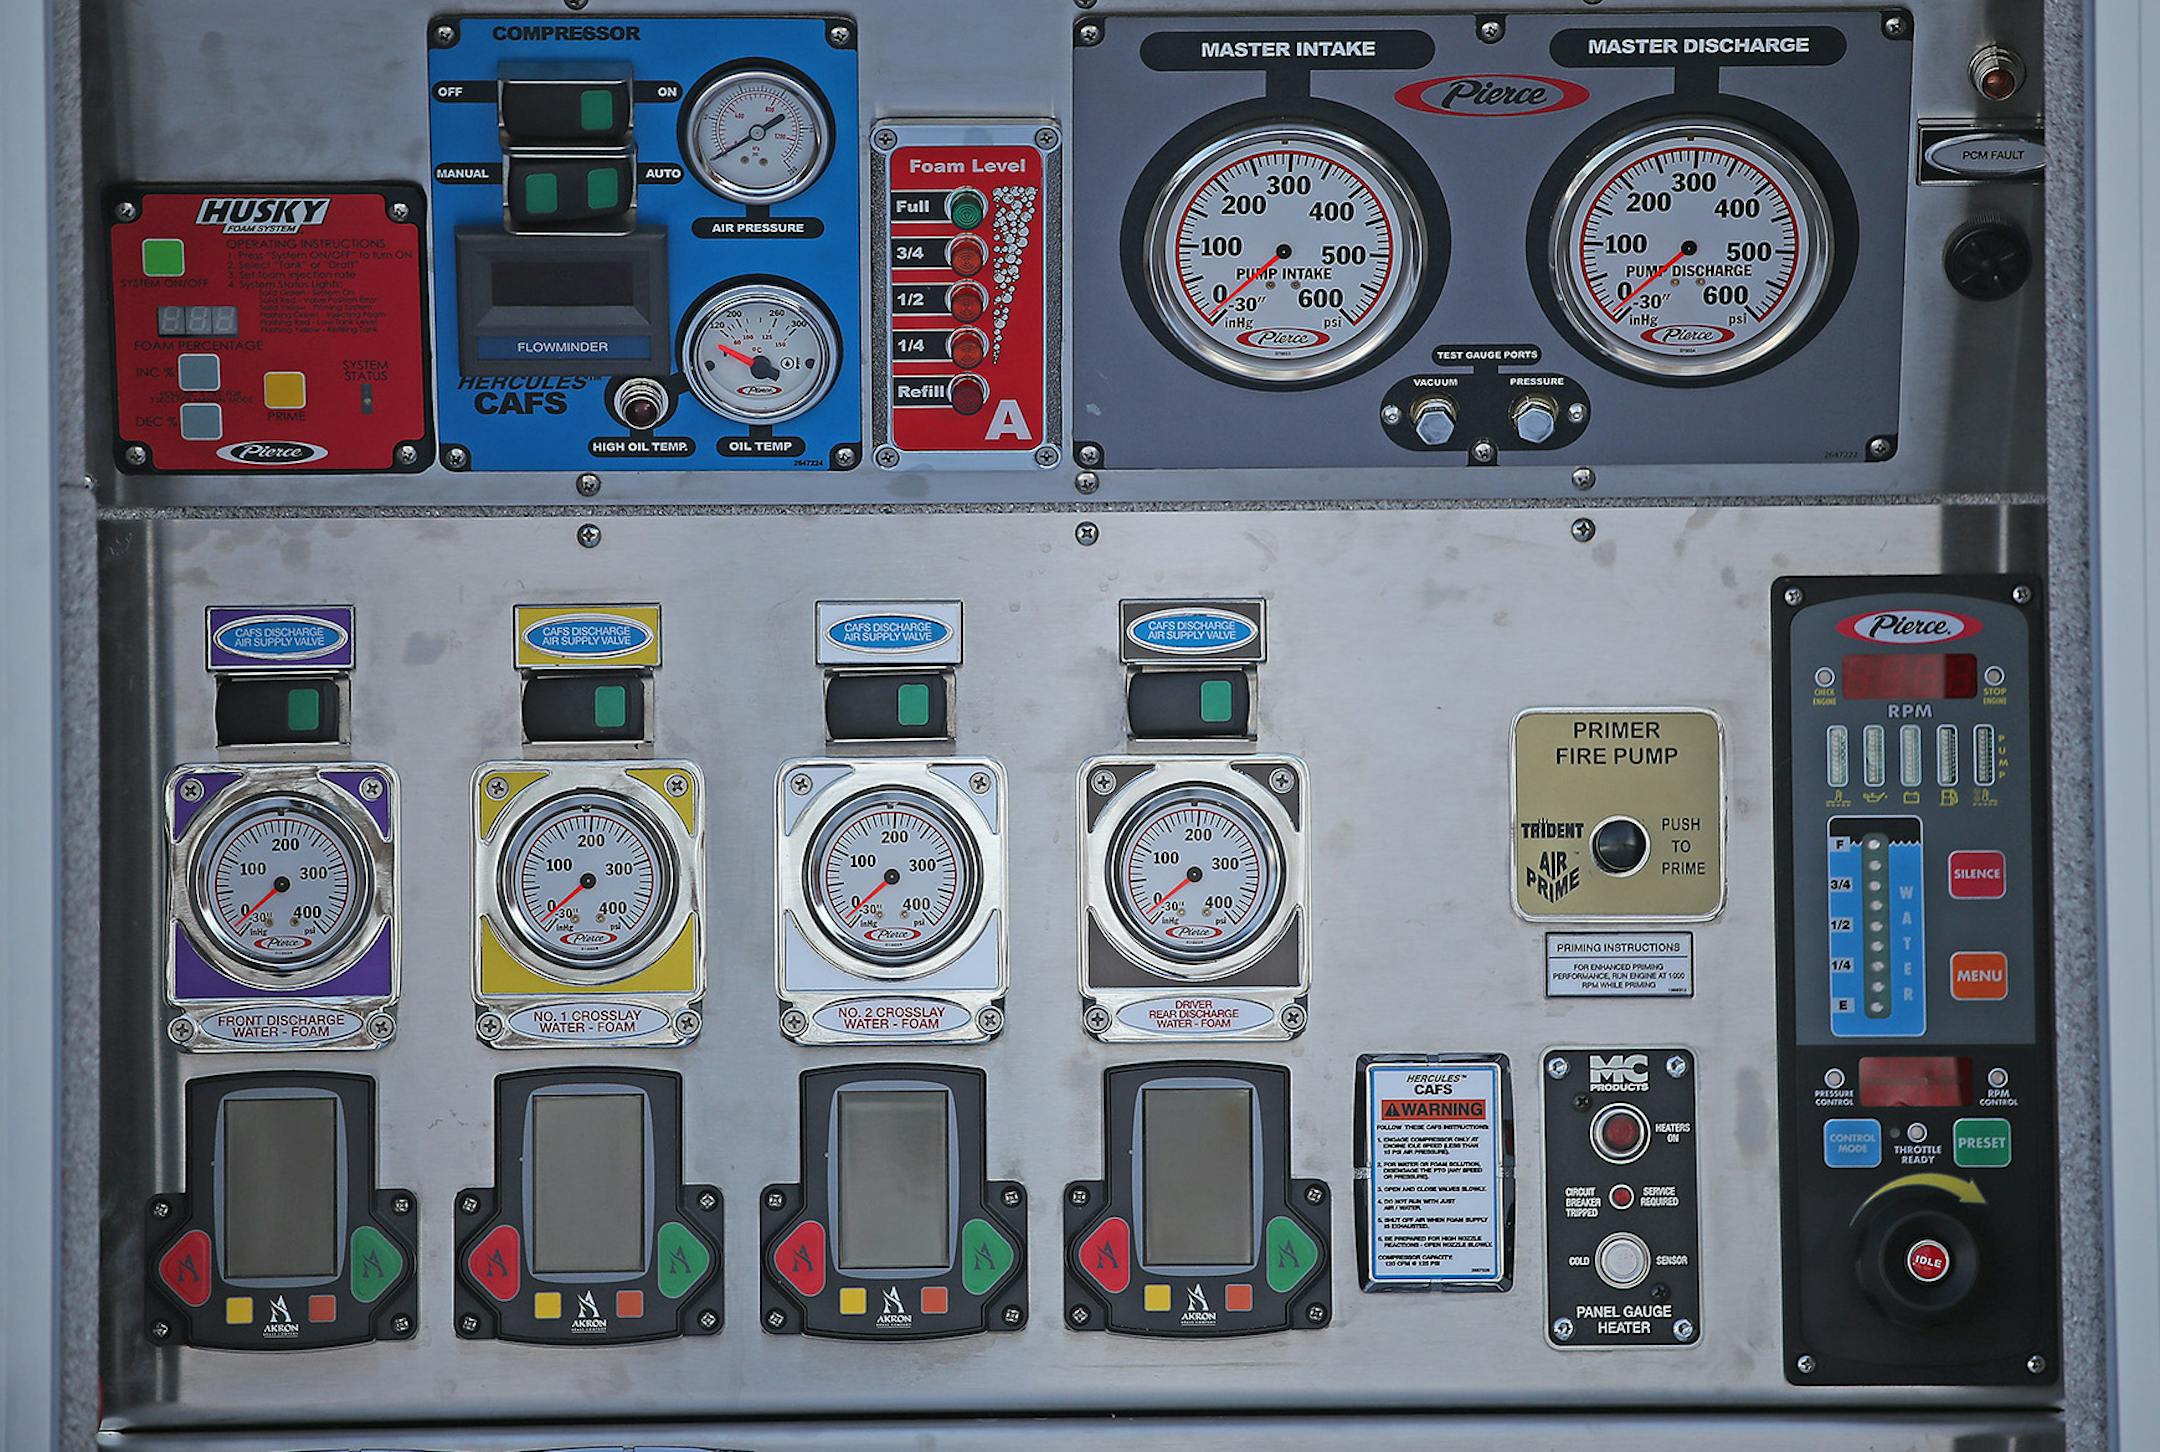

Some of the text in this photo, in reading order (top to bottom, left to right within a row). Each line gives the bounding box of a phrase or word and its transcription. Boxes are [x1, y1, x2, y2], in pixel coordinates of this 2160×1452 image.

[493, 27, 640, 41] COMPRESSOR
[1202, 42, 1375, 57] MASTER INTAKE
[1589, 38, 1809, 54] MASTER DISCHARGE
[438, 88, 462, 97] OFF
[658, 87, 677, 97] ON
[1442, 80, 1547, 109] Pierce
[1963, 151, 2024, 160] PCM FAULT
[910, 159, 1026, 173] Foam Level
[437, 170, 489, 179] MANUAL
[646, 169, 682, 179] AUTO
[1267, 176, 1310, 194] 300
[1672, 173, 1716, 192] 300
[897, 200, 929, 213] Full
[1221, 196, 1266, 215] 200
[1626, 193, 1671, 212] 200
[202, 199, 328, 223] HUSKY
[1309, 202, 1354, 221] 400
[1714, 199, 1760, 218] 400
[712, 224, 804, 233] AIR PRESSURE
[226, 239, 386, 249] OPERATING INSTRUCTIONS
[1201, 237, 1242, 256] 100
[1606, 235, 1647, 254] 100
[897, 247, 924, 259] 3/4
[1322, 246, 1365, 265] 500
[1726, 242, 1772, 261] 500
[1282, 268, 1331, 280] INTAKE
[1672, 265, 1751, 277] DISCHARGE
[897, 294, 924, 306] 1/2
[1299, 289, 1343, 307] 600
[1703, 286, 1748, 305] 600
[135, 341, 263, 350] FOAM PERCENTAGE
[518, 342, 608, 352] FLOWMINDER
[898, 339, 924, 351] 1/4
[1466, 351, 1501, 359] GAUGE
[1504, 351, 1538, 359] PORTS
[344, 361, 389, 370] SYSTEM
[136, 368, 159, 377] INC
[344, 372, 388, 381] STATUS
[1510, 378, 1564, 386] PRESSURE
[898, 386, 944, 398] Refill
[475, 392, 567, 415] CAFS
[268, 412, 305, 421] PRIME
[985, 400, 1032, 440] A
[136, 417, 164, 427] DEC
[593, 442, 627, 452] HIGH
[630, 442, 650, 452] OIL
[729, 441, 792, 451] OIL TEMP
[239, 444, 302, 459] Pierce
[844, 623, 931, 631] CAFS DISCHARGE
[1148, 621, 1235, 630] CAFS DISCHARGE
[236, 628, 324, 637] CAFS DISCHARGE
[543, 627, 630, 636] CAFS DISCHARGE
[844, 632, 932, 641] AIR SUPPLY VALVE
[1148, 631, 1236, 640] AIR SUPPLY VALVE
[235, 637, 324, 646] AIR SUPPLY VALVE
[542, 636, 631, 645] AIR SUPPLY VALVE
[1888, 705, 1932, 718] RPM
[1574, 722, 1660, 738] PRIMER
[1557, 748, 1678, 764] FIRE PUMP
[1662, 818, 1700, 831] PUSH
[1672, 840, 1691, 852] TO
[1837, 840, 1843, 848] F
[1539, 851, 1567, 880] AIR
[1662, 862, 1705, 875] PRIME
[1954, 869, 2000, 879] SILENCE
[1527, 867, 1580, 903] PRIME
[1831, 881, 1850, 889] 3/4
[1831, 921, 1850, 930] 1/2
[1557, 943, 1680, 952] PRIMING INSTRUCTIONS
[1900, 886, 1914, 1000] WATER
[1832, 961, 1851, 969] 1/4
[1957, 970, 2002, 982] MENU
[1175, 1001, 1212, 1009] DRIVER
[1839, 1001, 1847, 1010] E
[534, 1011, 642, 1021] NO. 1 CROSSLAY
[839, 1007, 945, 1017] NO. 2 CROSSLAY
[1150, 1009, 1239, 1019] REAR DISCHARGE
[218, 1015, 345, 1026] FRONT DISCHARGE
[844, 1019, 939, 1029] WATER FOAM
[1157, 1019, 1231, 1028] WATER FOAM
[233, 1027, 330, 1037] WATER FOAM
[540, 1022, 635, 1032] WATER FOAM
[1590, 1054, 1648, 1083] MC
[1414, 1084, 1452, 1094] CAFS
[1590, 1083, 1649, 1091] PRODUCTS
[1815, 1090, 1854, 1098] PRESSURE
[1988, 1089, 2010, 1098] RPM
[1401, 1103, 1483, 1116] WARNING
[1655, 1124, 1690, 1132] HEATERS
[1667, 1134, 1679, 1142] ON
[1830, 1134, 1876, 1143] CONTROL
[1958, 1137, 2006, 1149] PRESET
[1838, 1145, 1868, 1153] MODE
[1894, 1146, 1942, 1154] THROTTLE
[1901, 1156, 1935, 1164] READY
[1565, 1187, 1596, 1196] CIRCUIT
[1643, 1187, 1675, 1196] SERVICE
[1566, 1198, 1601, 1207] BREAKER
[1641, 1197, 1679, 1206] REQUIRED
[1566, 1209, 1598, 1217] TRIPPED
[1569, 1257, 1590, 1266] COLD
[1656, 1256, 1688, 1265] SENSOR
[1914, 1255, 1942, 1268] IDLE
[1181, 1312, 1216, 1321] AKRON
[1576, 1305, 1672, 1318] PANEL GAUGE
[571, 1319, 607, 1328] AKRON
[877, 1315, 912, 1323] AKRON
[263, 1323, 299, 1333] AKRON
[1598, 1322, 1650, 1334] HEATER
